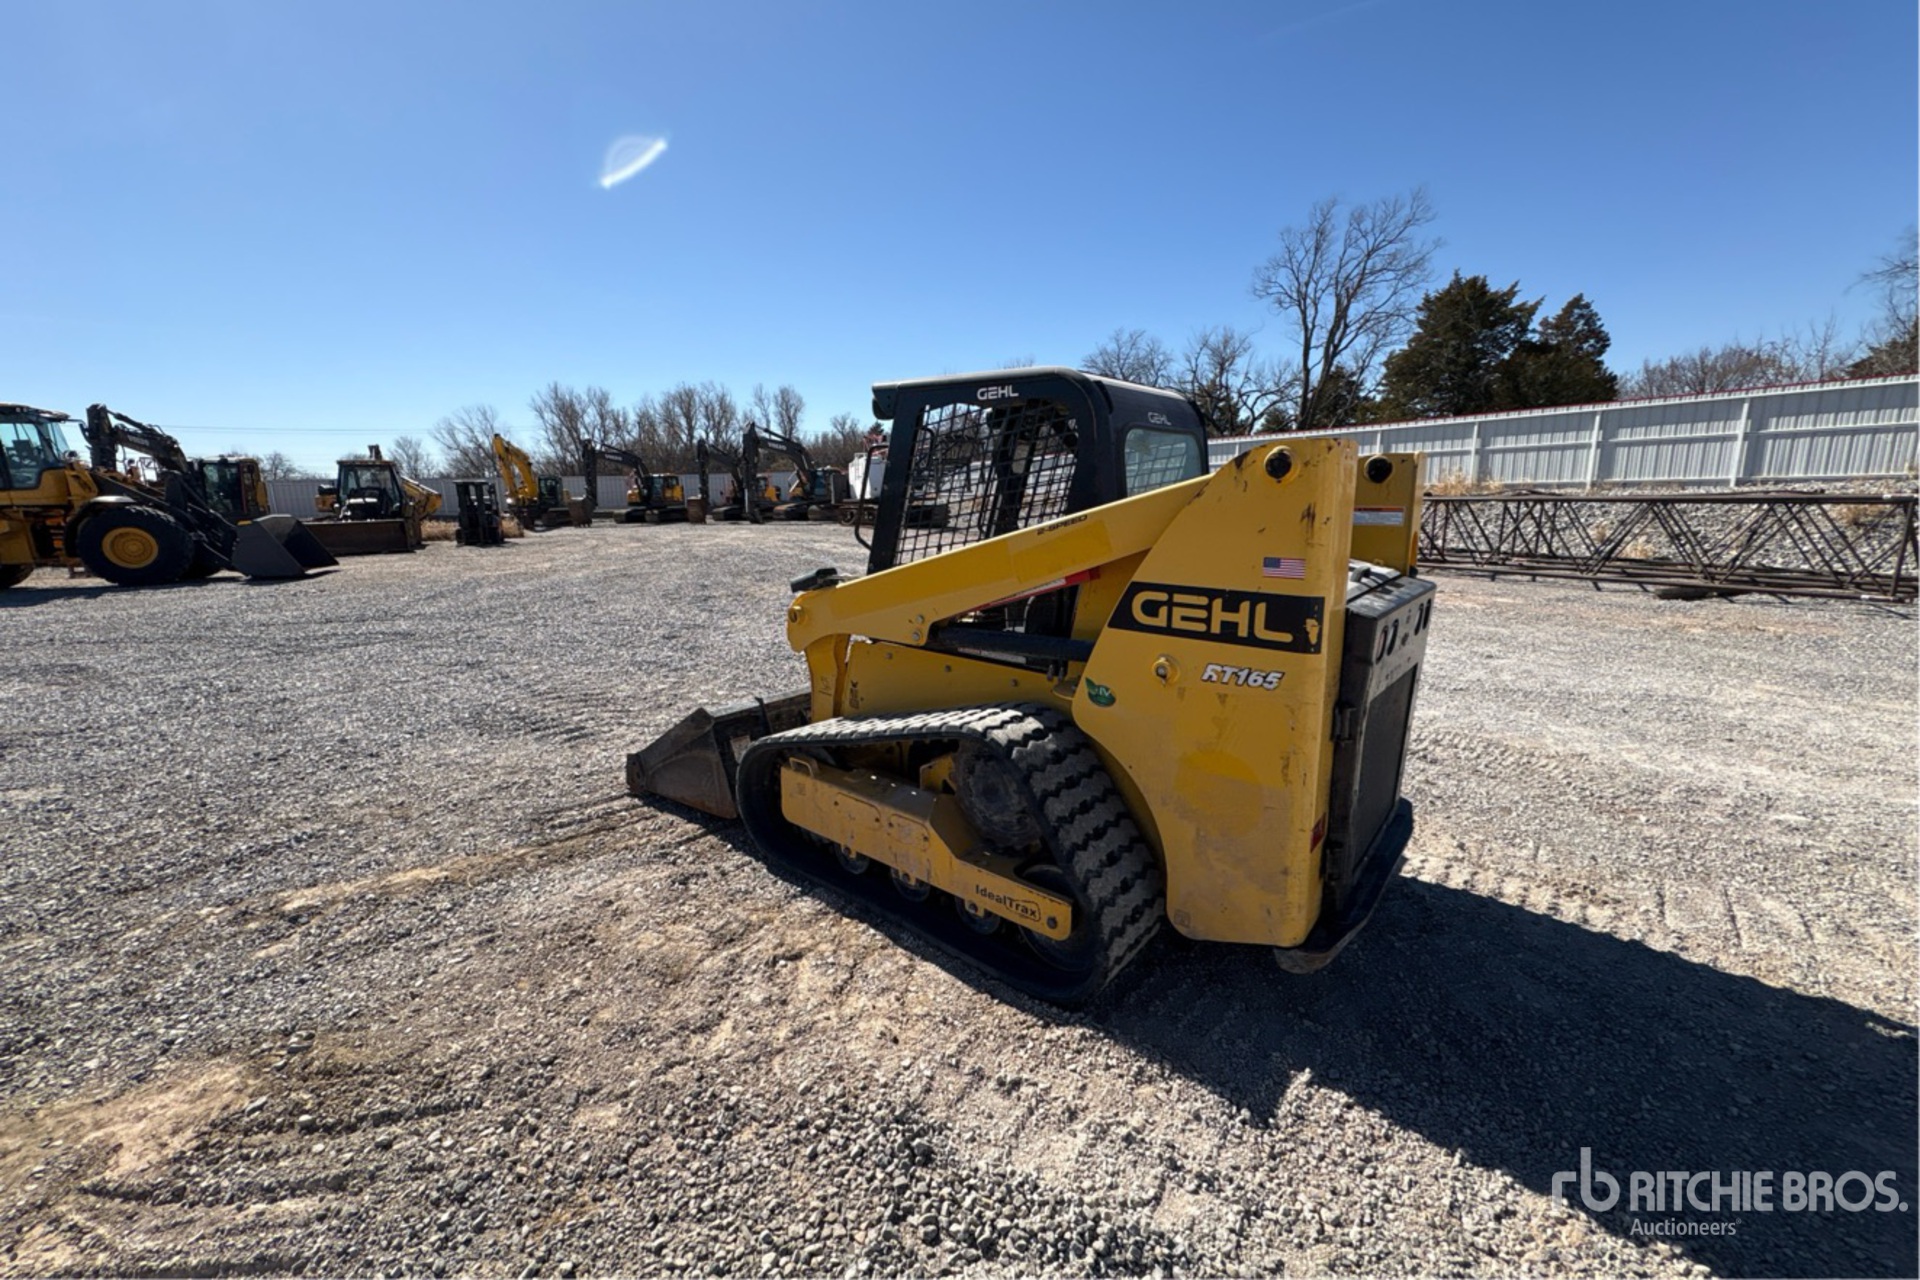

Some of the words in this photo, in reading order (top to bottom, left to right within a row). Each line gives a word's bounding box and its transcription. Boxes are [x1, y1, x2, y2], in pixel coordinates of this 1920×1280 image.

[977, 385, 1019, 400] GEHL
[1131, 591, 1294, 643] GEHL
[1201, 663, 1285, 691] RT165
[975, 884, 1038, 919] IdealTrax
